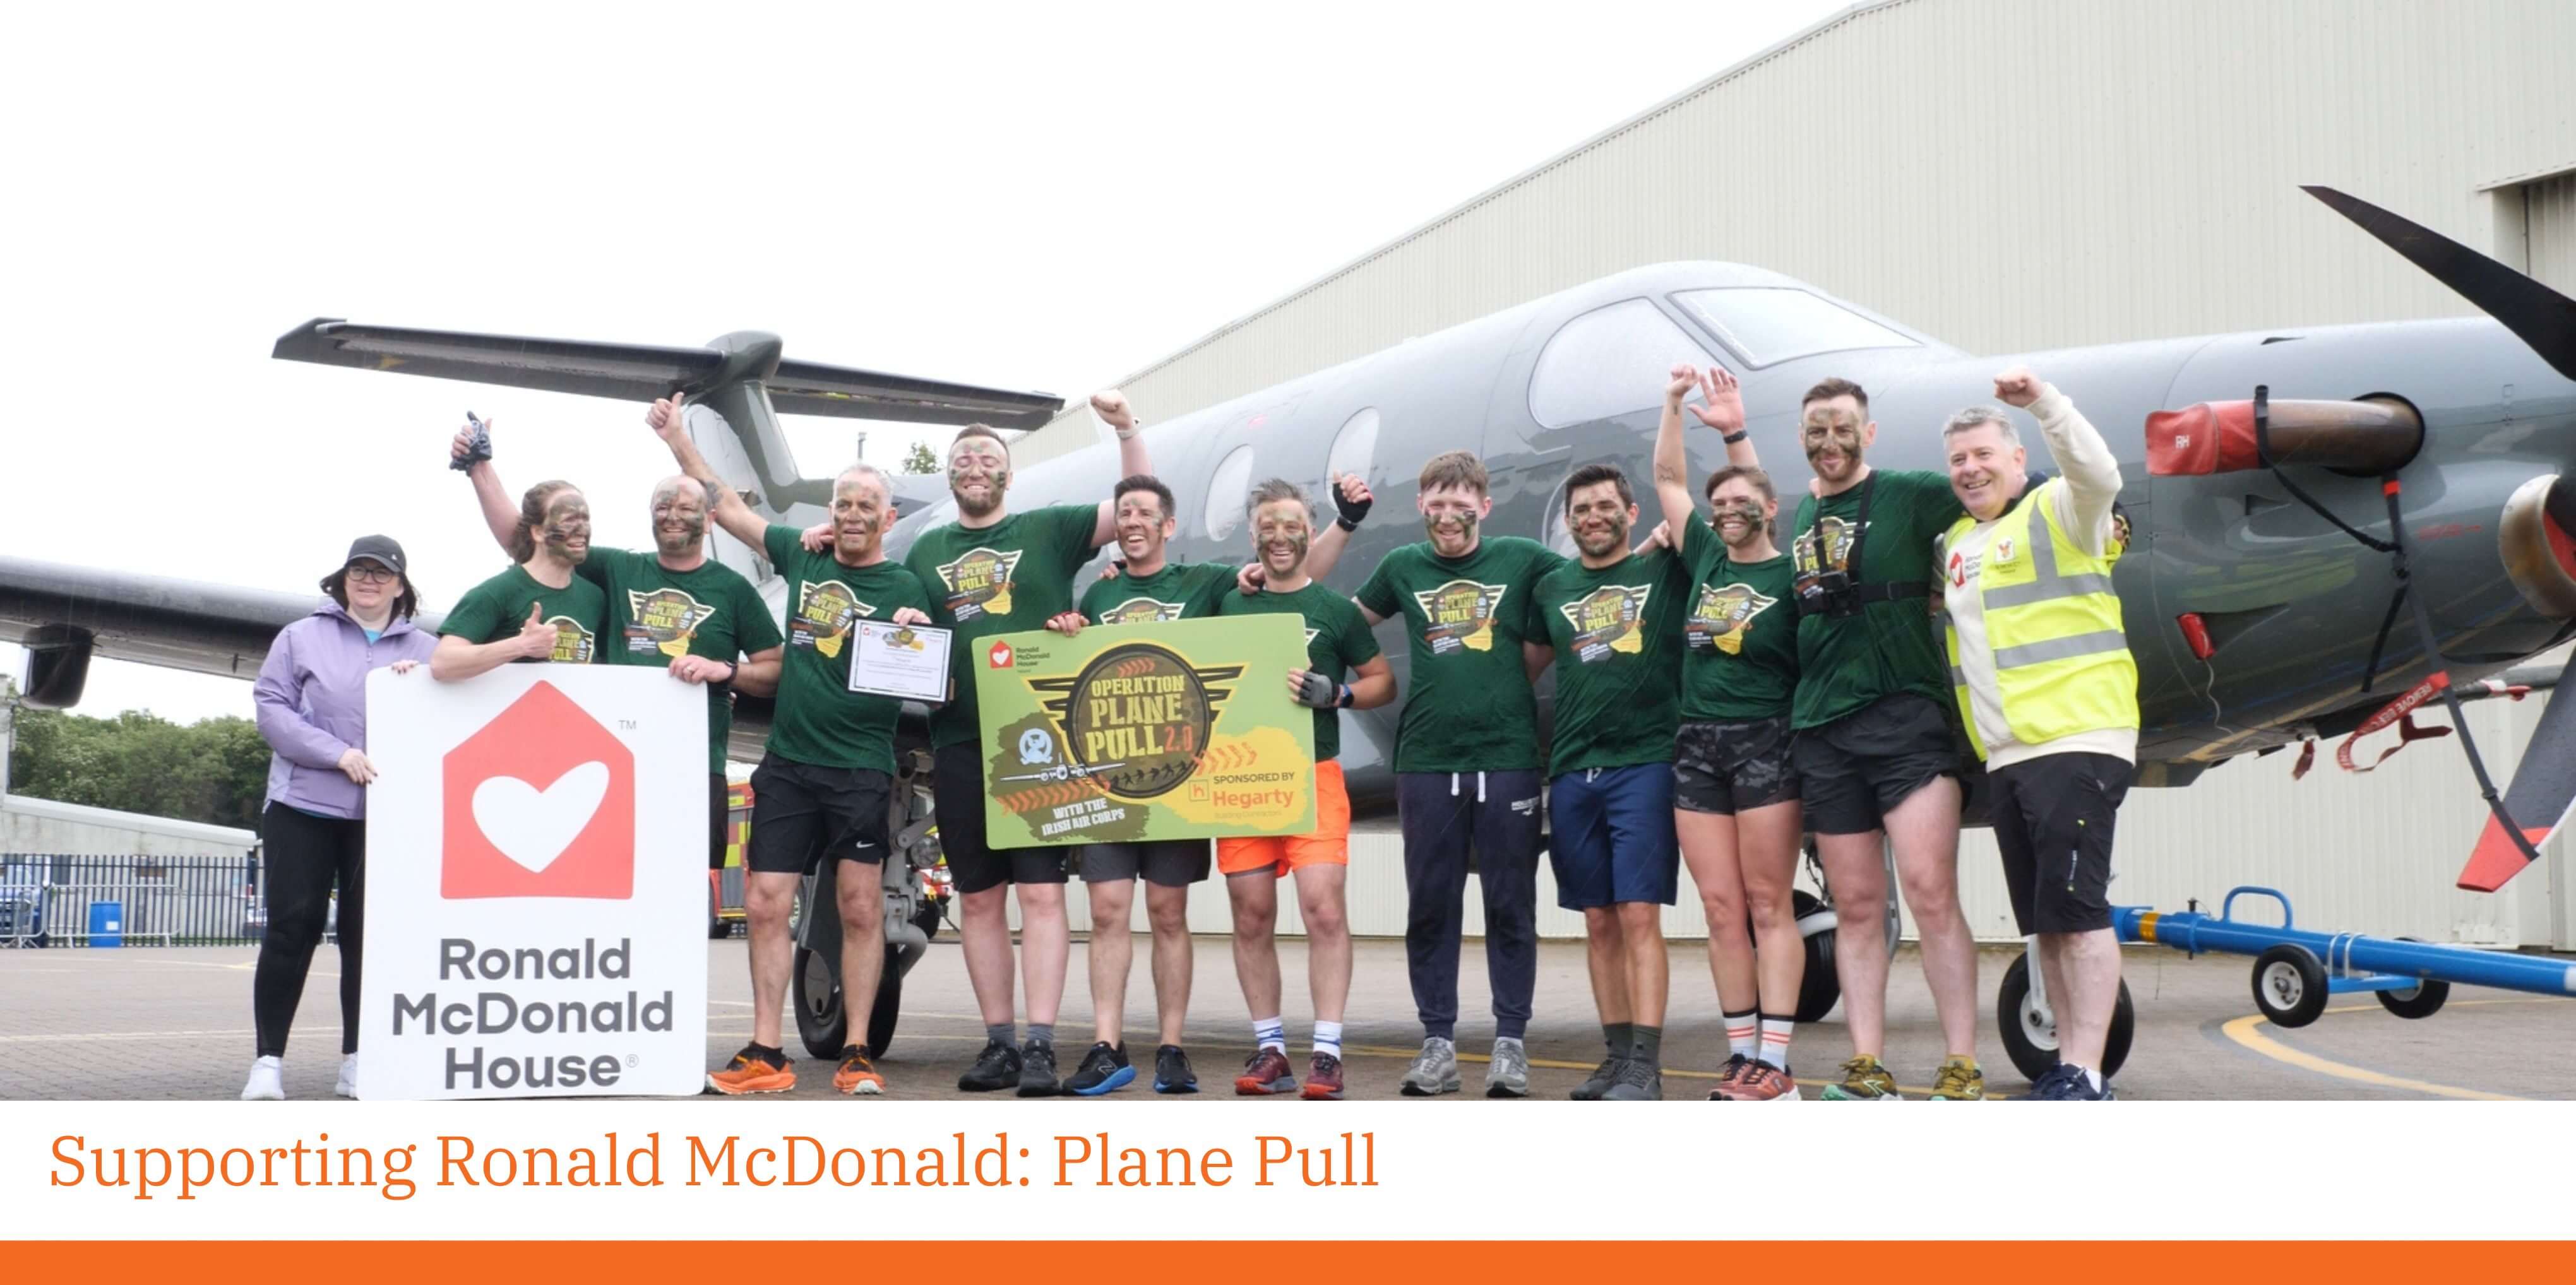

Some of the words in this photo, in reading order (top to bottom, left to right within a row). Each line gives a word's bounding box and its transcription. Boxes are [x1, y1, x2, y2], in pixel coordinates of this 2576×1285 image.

[958, 575, 990, 592] PULL
[643, 613, 674, 629] PULL
[806, 605, 832, 624] PULL
[1438, 608, 1471, 624] PULL
[1585, 613, 1618, 632] PULL
[1091, 675, 1185, 697] OPERATION
[1090, 693, 1183, 728] PLANE
[1085, 725, 1164, 763] PULL
[1164, 725, 1193, 752] 2.0
[1213, 773, 1280, 785] SPONSORED
[1281, 772, 1295, 781] BY
[1052, 803, 1084, 819] WITH
[1083, 798, 1108, 812] THE
[1212, 788, 1294, 809] Hegarty
[1041, 819, 1072, 836] IRISH
[1072, 815, 1092, 829] AIR
[1091, 808, 1126, 826] CORPS
[440, 938, 630, 980] Ronald
[393, 991, 672, 1036] McDonald
[445, 1047, 621, 1089] House
